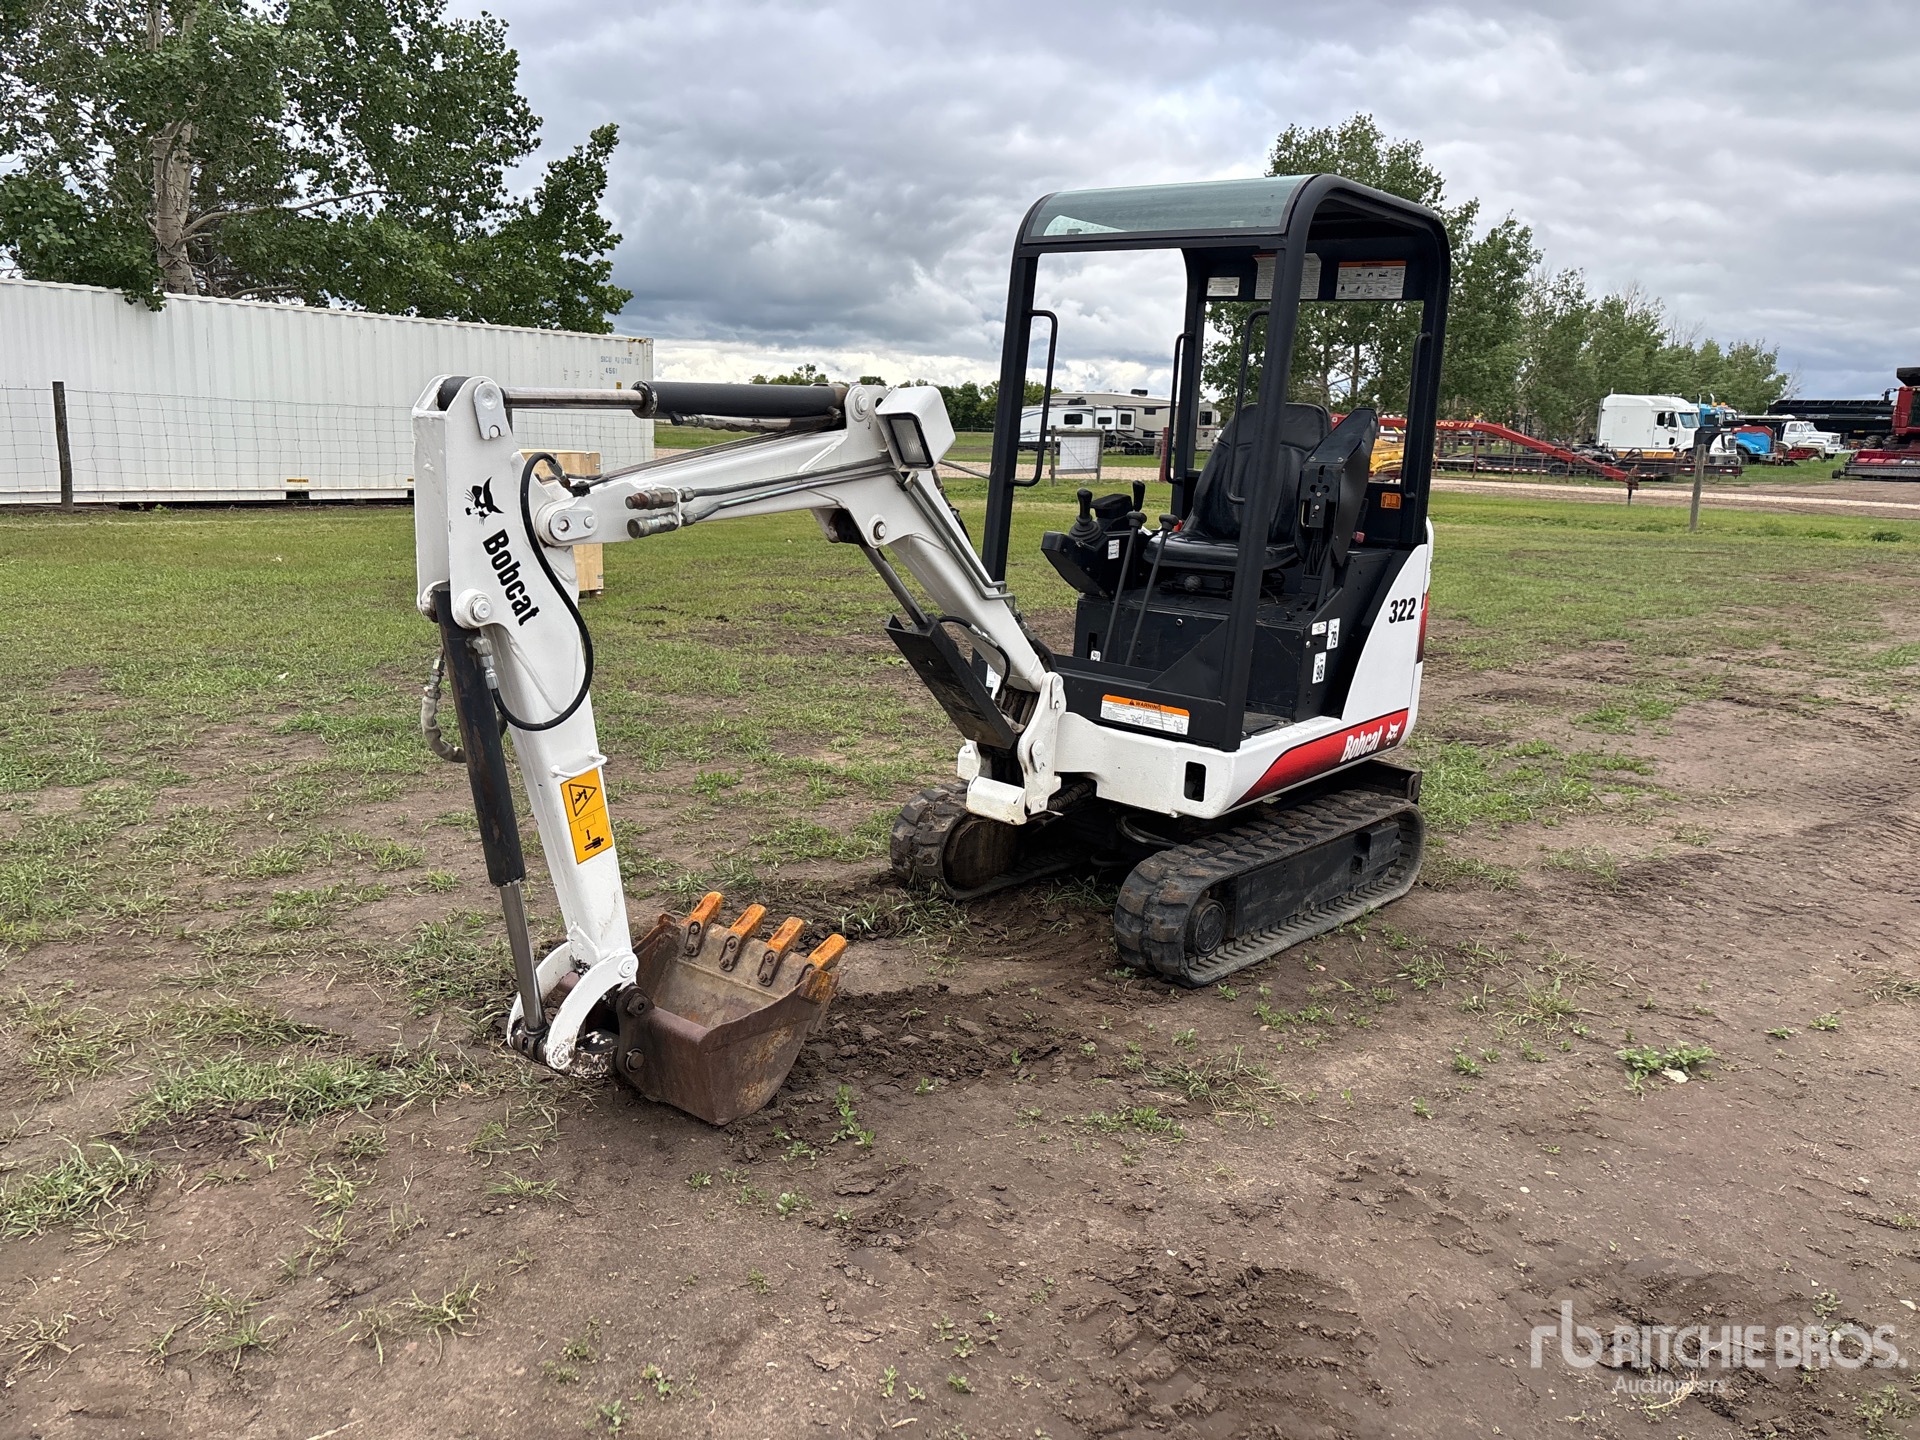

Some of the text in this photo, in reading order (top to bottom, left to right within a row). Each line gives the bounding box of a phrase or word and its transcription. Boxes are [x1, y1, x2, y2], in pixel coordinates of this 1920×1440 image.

[482, 528, 540, 626] Bobcat
[1388, 597, 1416, 624] 322
[1136, 701, 1161, 711] WARNING
[1339, 725, 1384, 763] Bobcat
